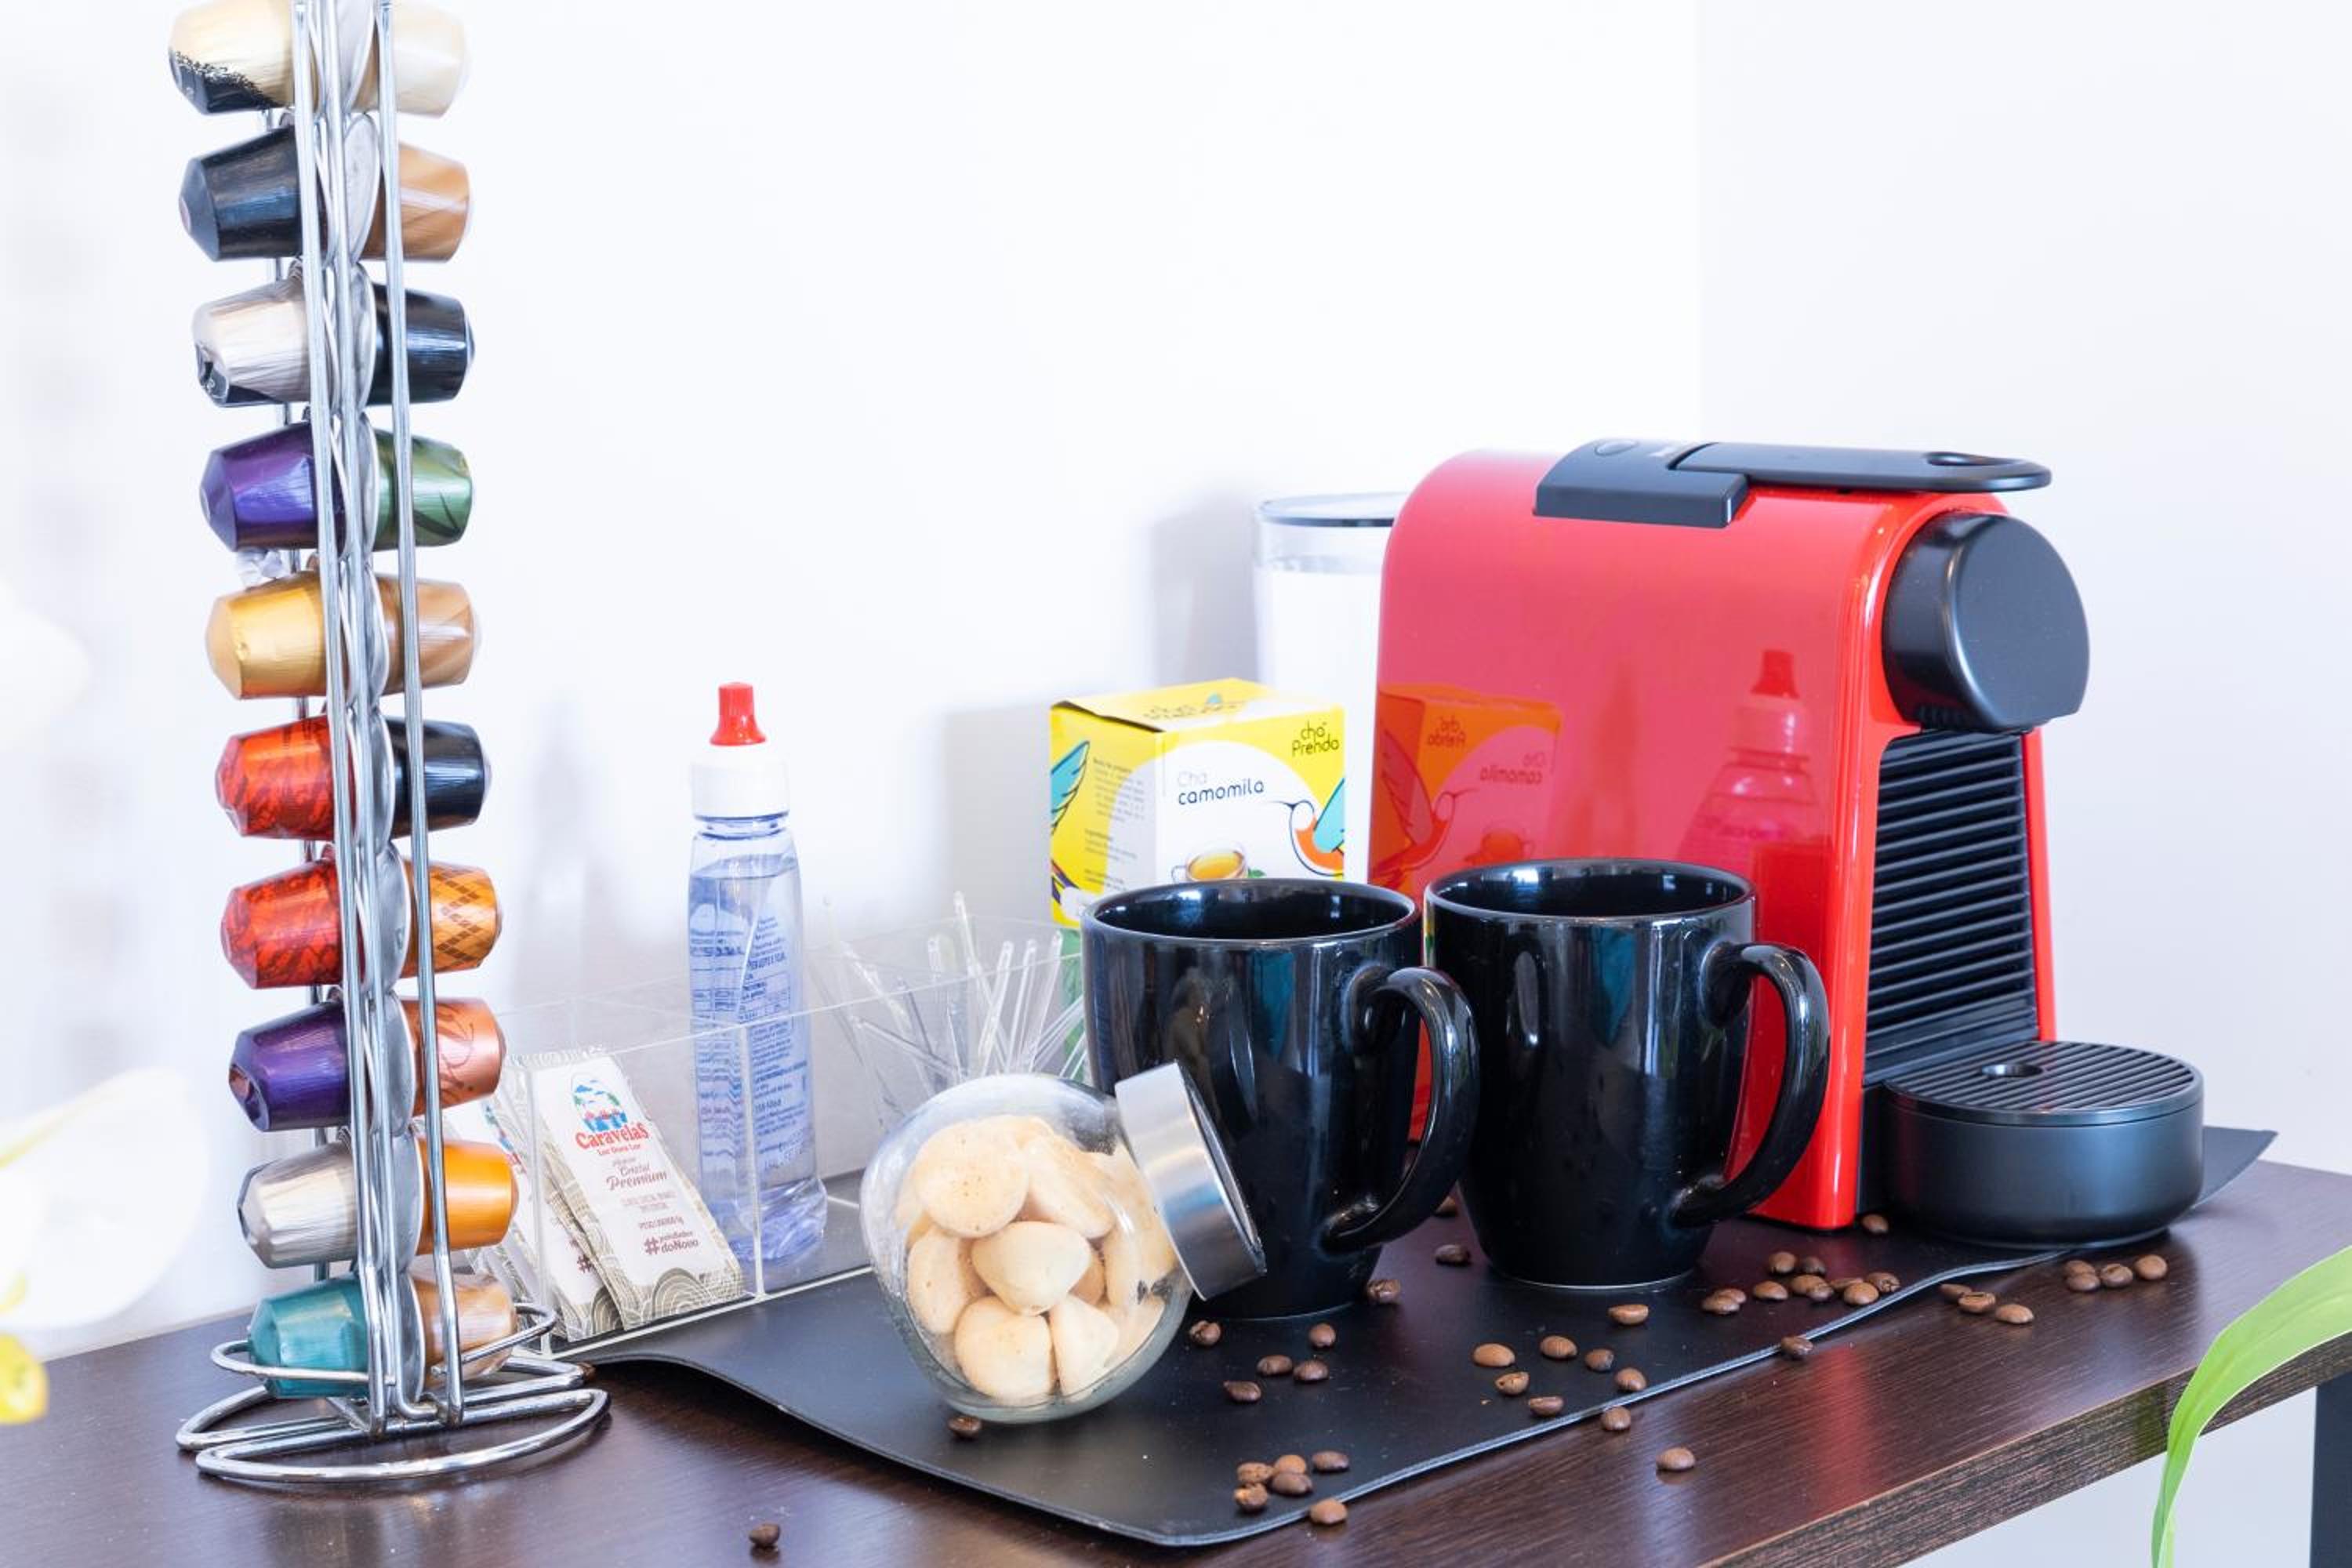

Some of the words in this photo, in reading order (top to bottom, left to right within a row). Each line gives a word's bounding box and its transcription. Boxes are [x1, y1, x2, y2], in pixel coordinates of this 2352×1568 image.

[1178, 778, 1265, 805] camomila
[575, 1122, 650, 1150] Caravelas
[605, 1171, 668, 1191] Premium
